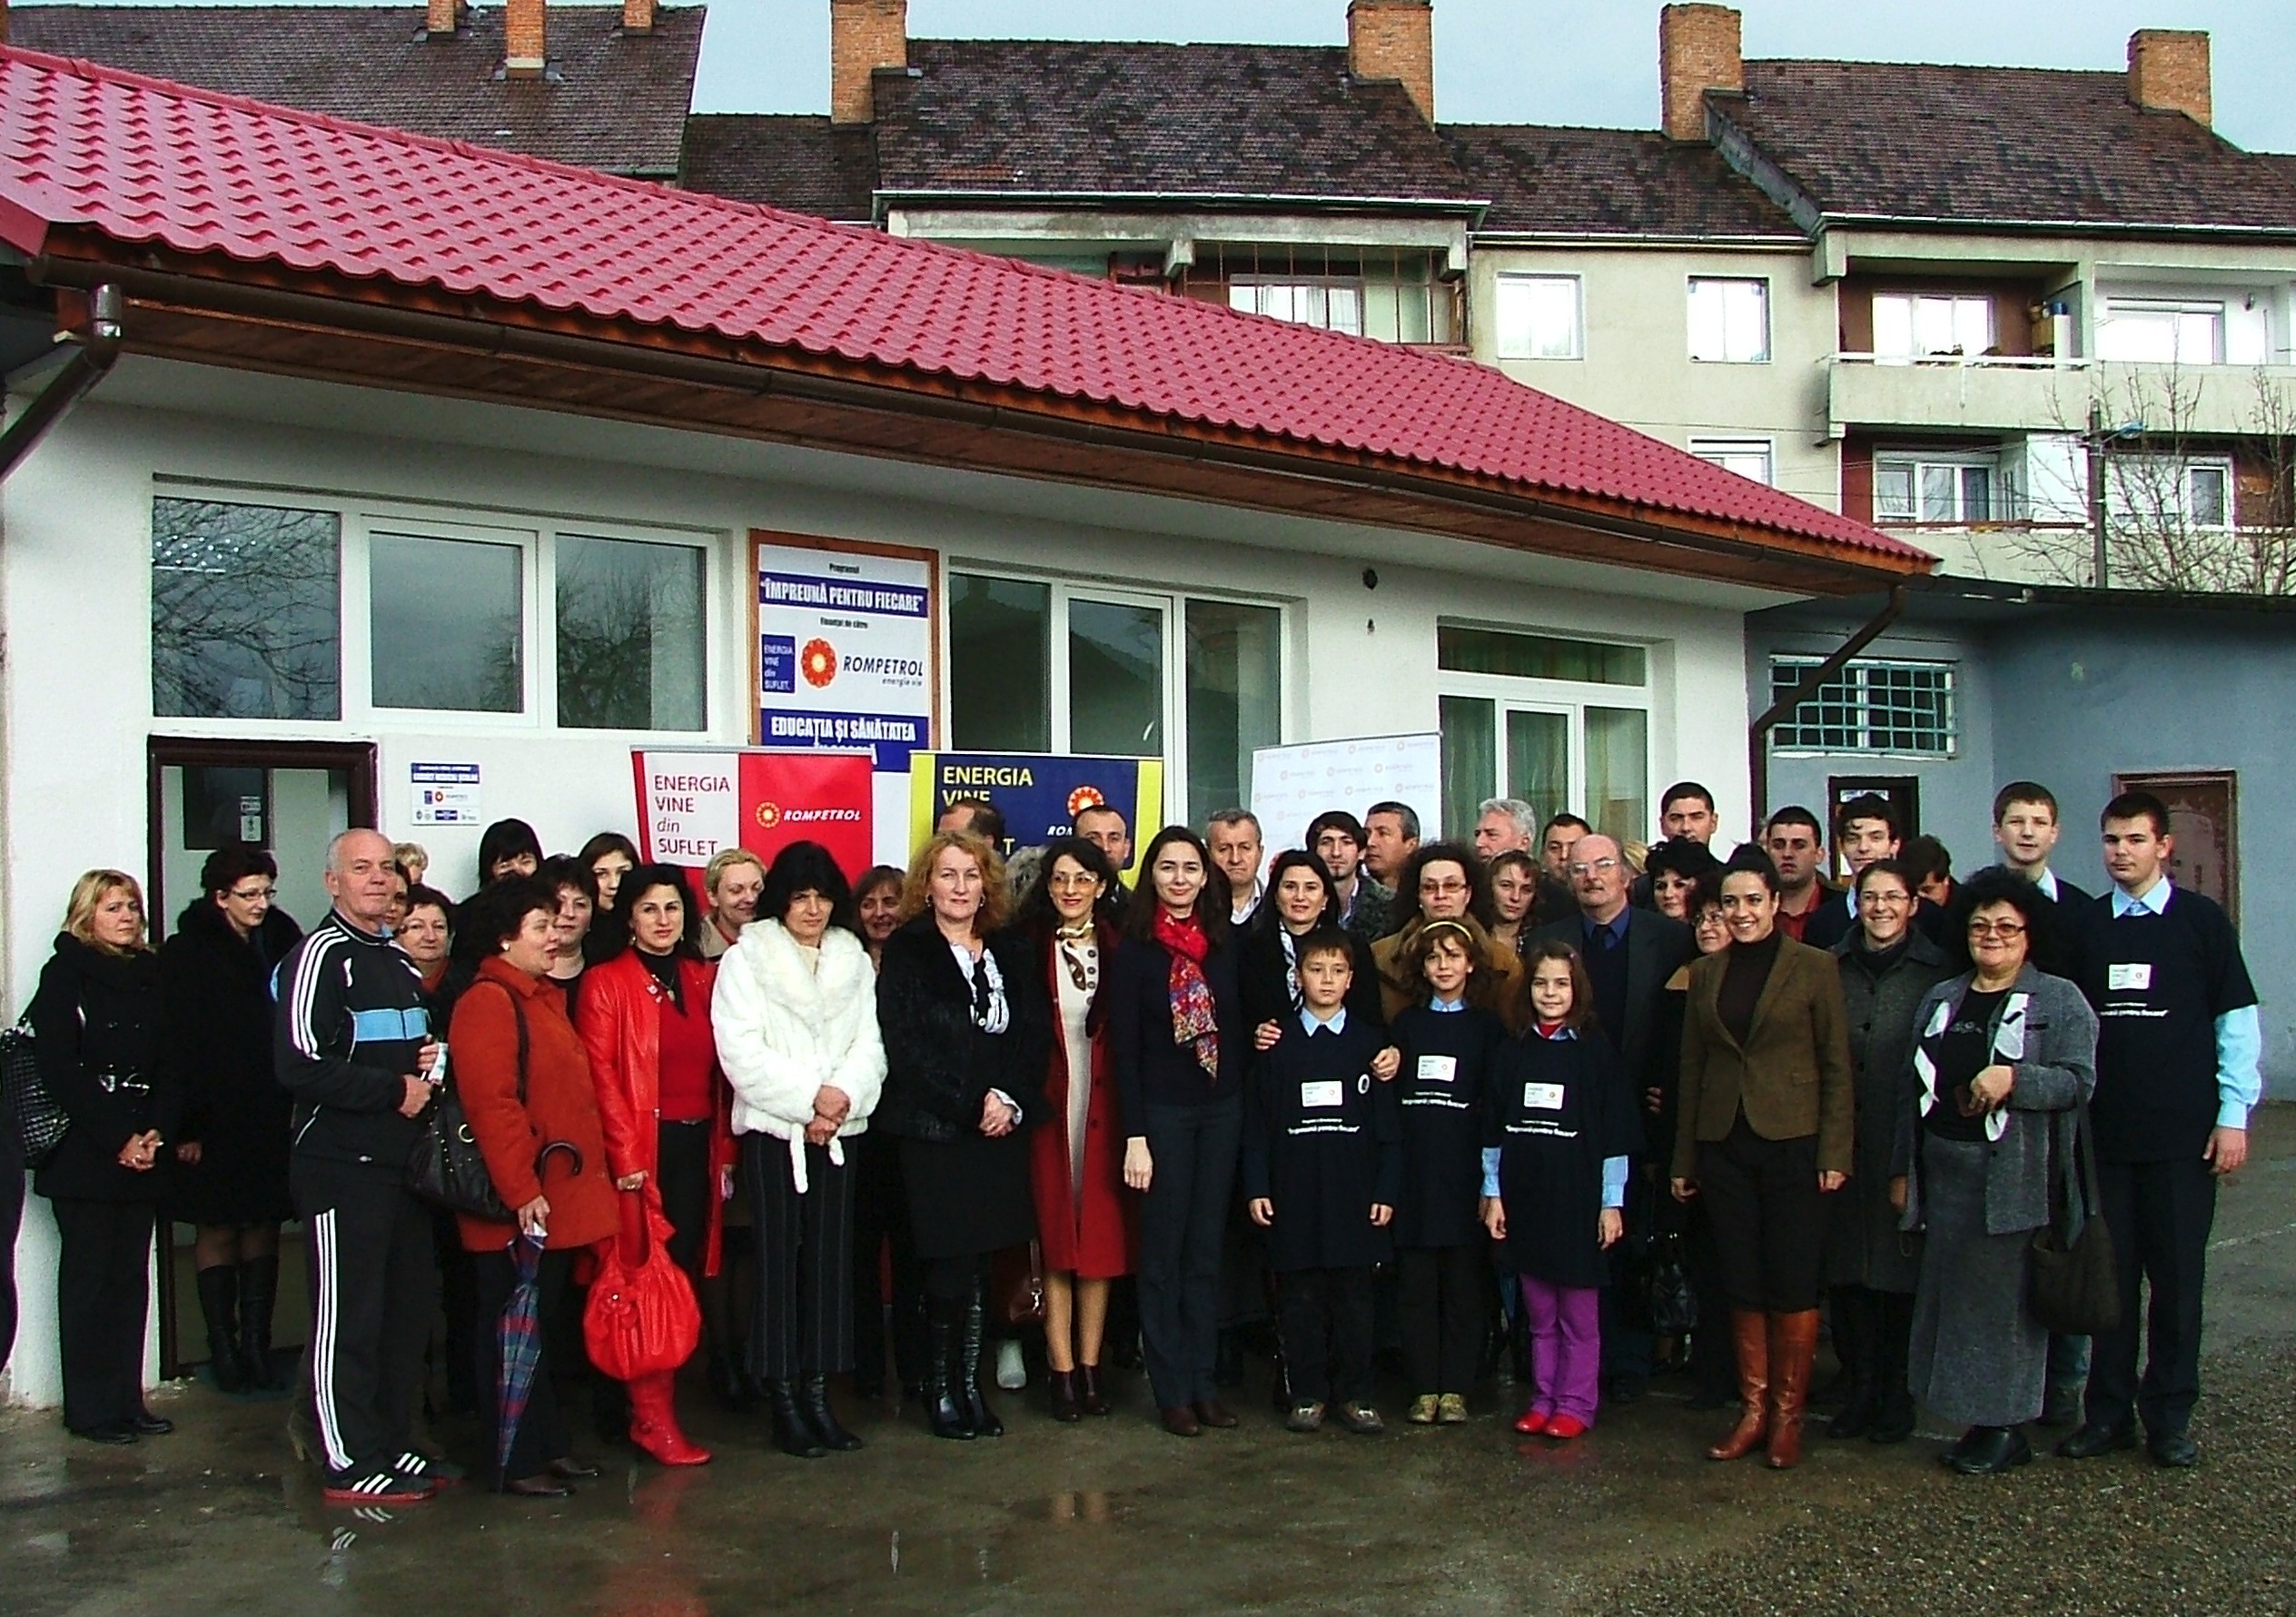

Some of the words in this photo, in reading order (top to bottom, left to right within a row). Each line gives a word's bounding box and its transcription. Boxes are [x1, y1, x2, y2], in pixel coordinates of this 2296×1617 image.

[829, 586, 873, 608] PENTRU
[843, 656, 923, 677] ROMPETROL
[654, 775, 731, 792] ENERGIA
[943, 766, 1034, 787] ENERGIA
[654, 797, 695, 813] VINE
[784, 808, 862, 822] ROMPETROL
[657, 817, 680, 834] din
[658, 838, 718, 856] SUFLET
